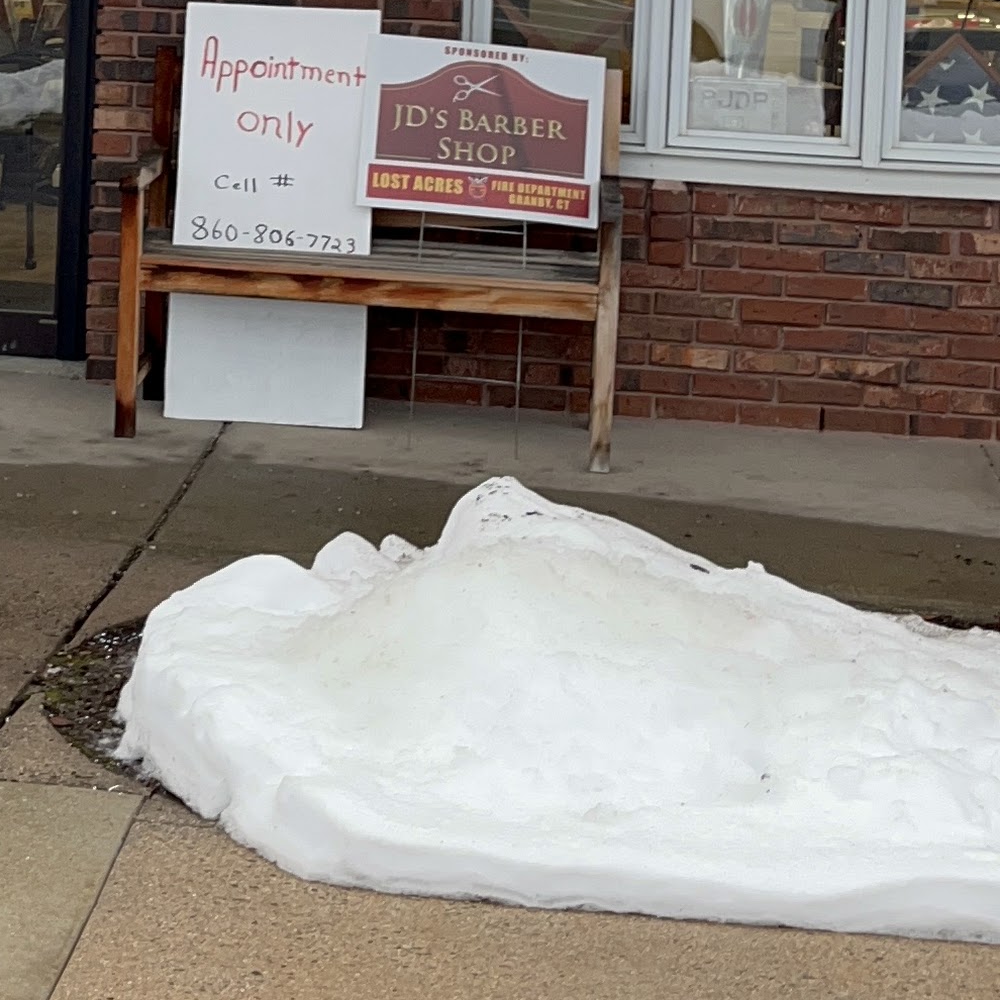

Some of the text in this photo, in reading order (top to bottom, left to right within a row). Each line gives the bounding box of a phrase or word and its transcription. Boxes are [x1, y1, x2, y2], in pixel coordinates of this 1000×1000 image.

[200, 35, 367, 93] Appointment
[444, 45, 530, 64] SPONSORED BY:
[458, 108, 567, 141] BARBER
[436, 136, 517, 166] SHOP
[213, 173, 295, 193] Cell #
[371, 172, 464, 195] LOST ACRES
[491, 180, 587, 200] FIRE DEPARTMENT
[508, 193, 571, 211] GRANBY, CT
[190, 215, 357, 254] 860-806-7723
